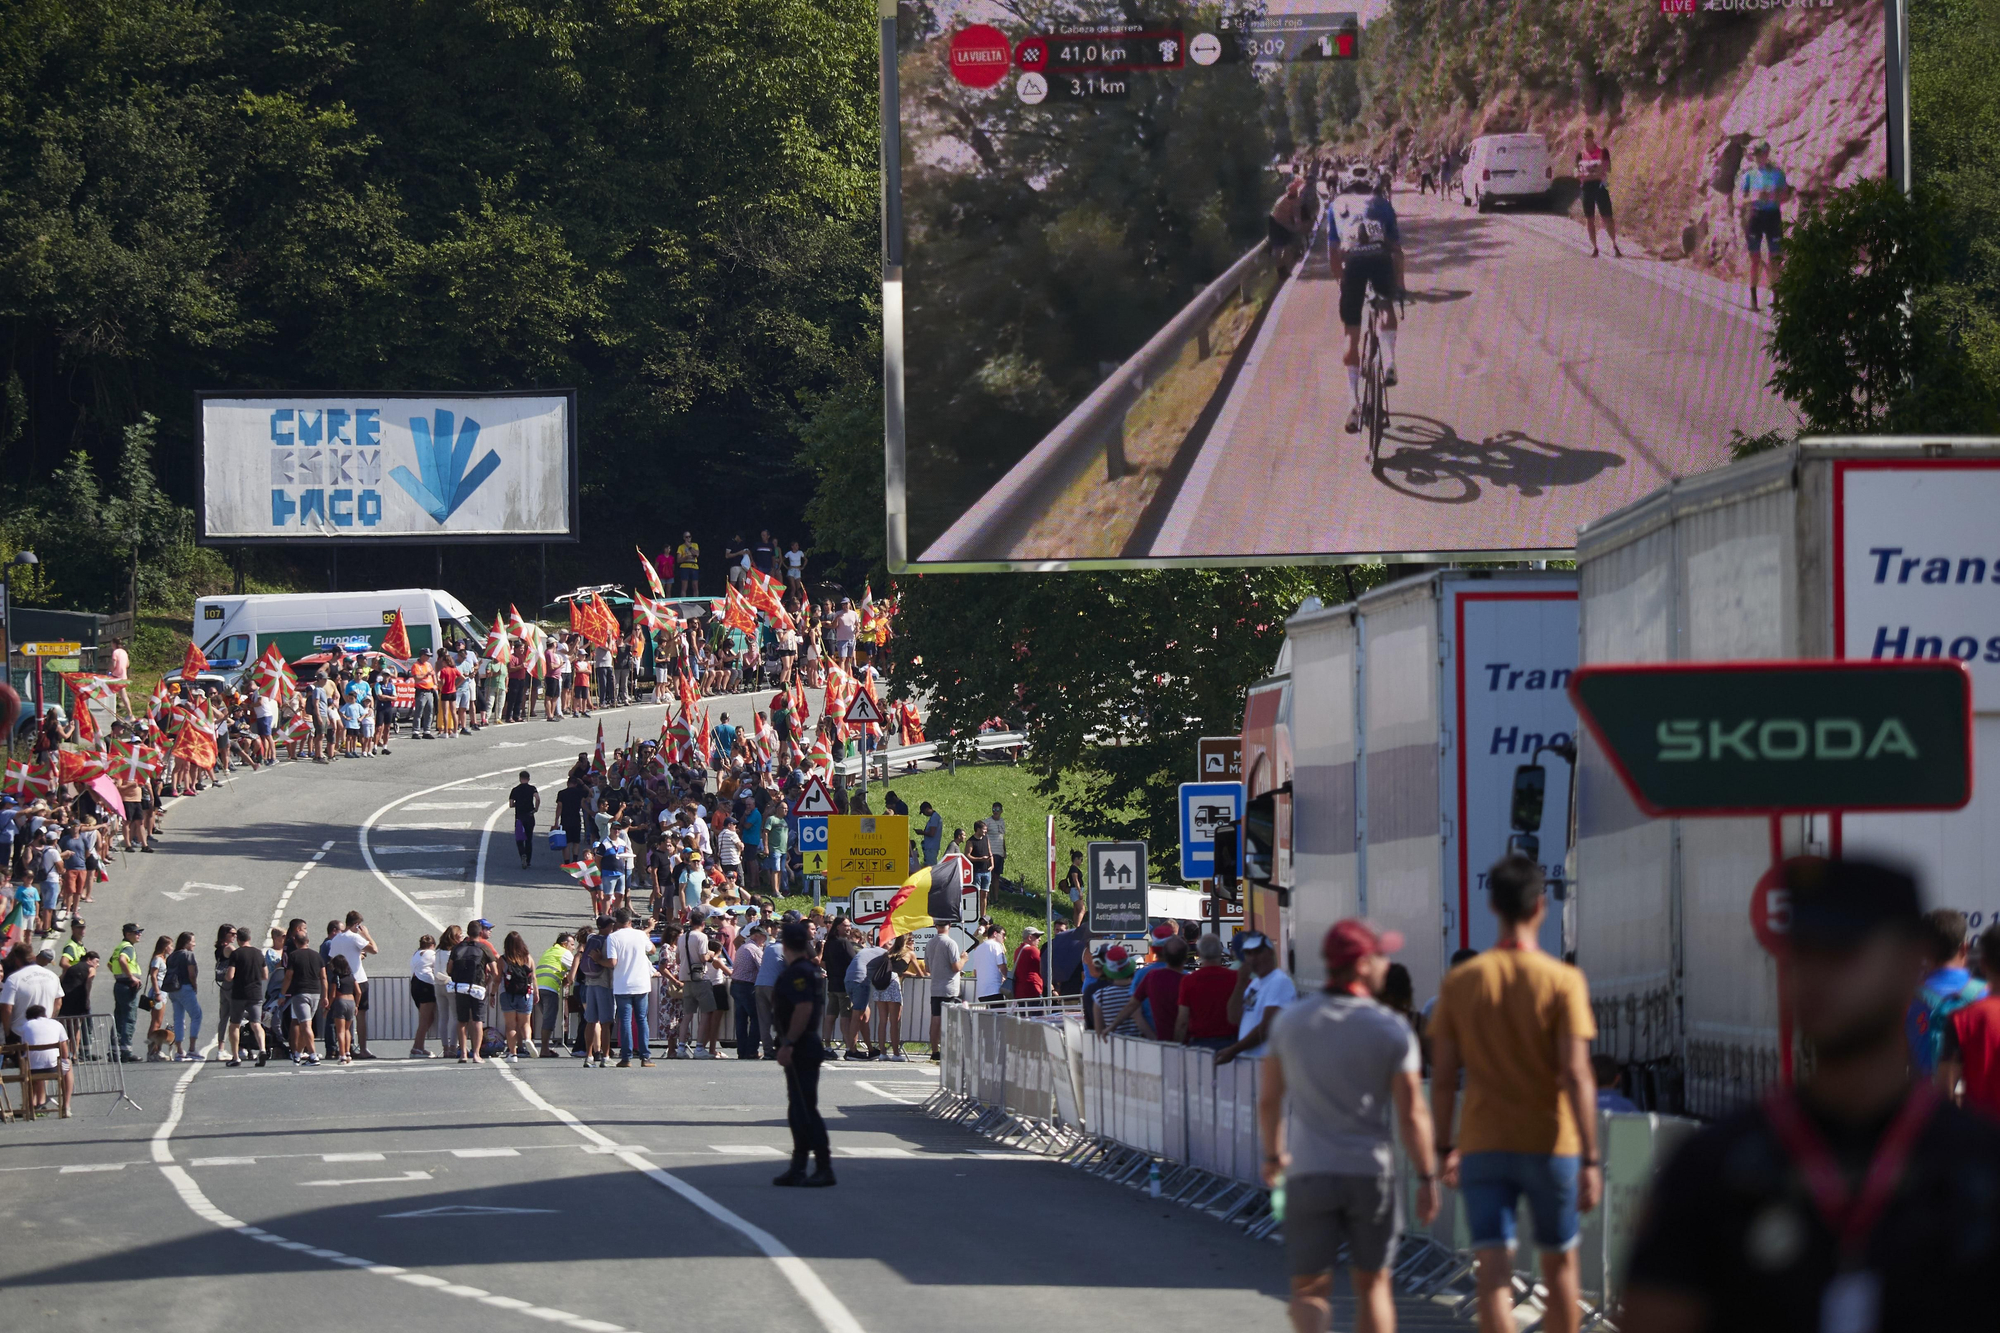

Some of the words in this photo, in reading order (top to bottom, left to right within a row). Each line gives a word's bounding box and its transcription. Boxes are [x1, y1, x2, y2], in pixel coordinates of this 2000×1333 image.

[1662, 0, 1692, 12] LIVE
[1060, 45, 1098, 63] 41,0
[1101, 44, 1127, 60] km
[1248, 39, 1286, 56] 3:09
[970, 50, 1002, 62] VUELTA
[1070, 79, 1095, 97] 3,1
[1100, 78, 1126, 94] km
[204, 610, 221, 619] 107
[312, 634, 371, 648] Europcar
[1656, 718, 1919, 761] SKODA
[802, 826, 828, 843] 60
[849, 847, 887, 856] MUGIRO
